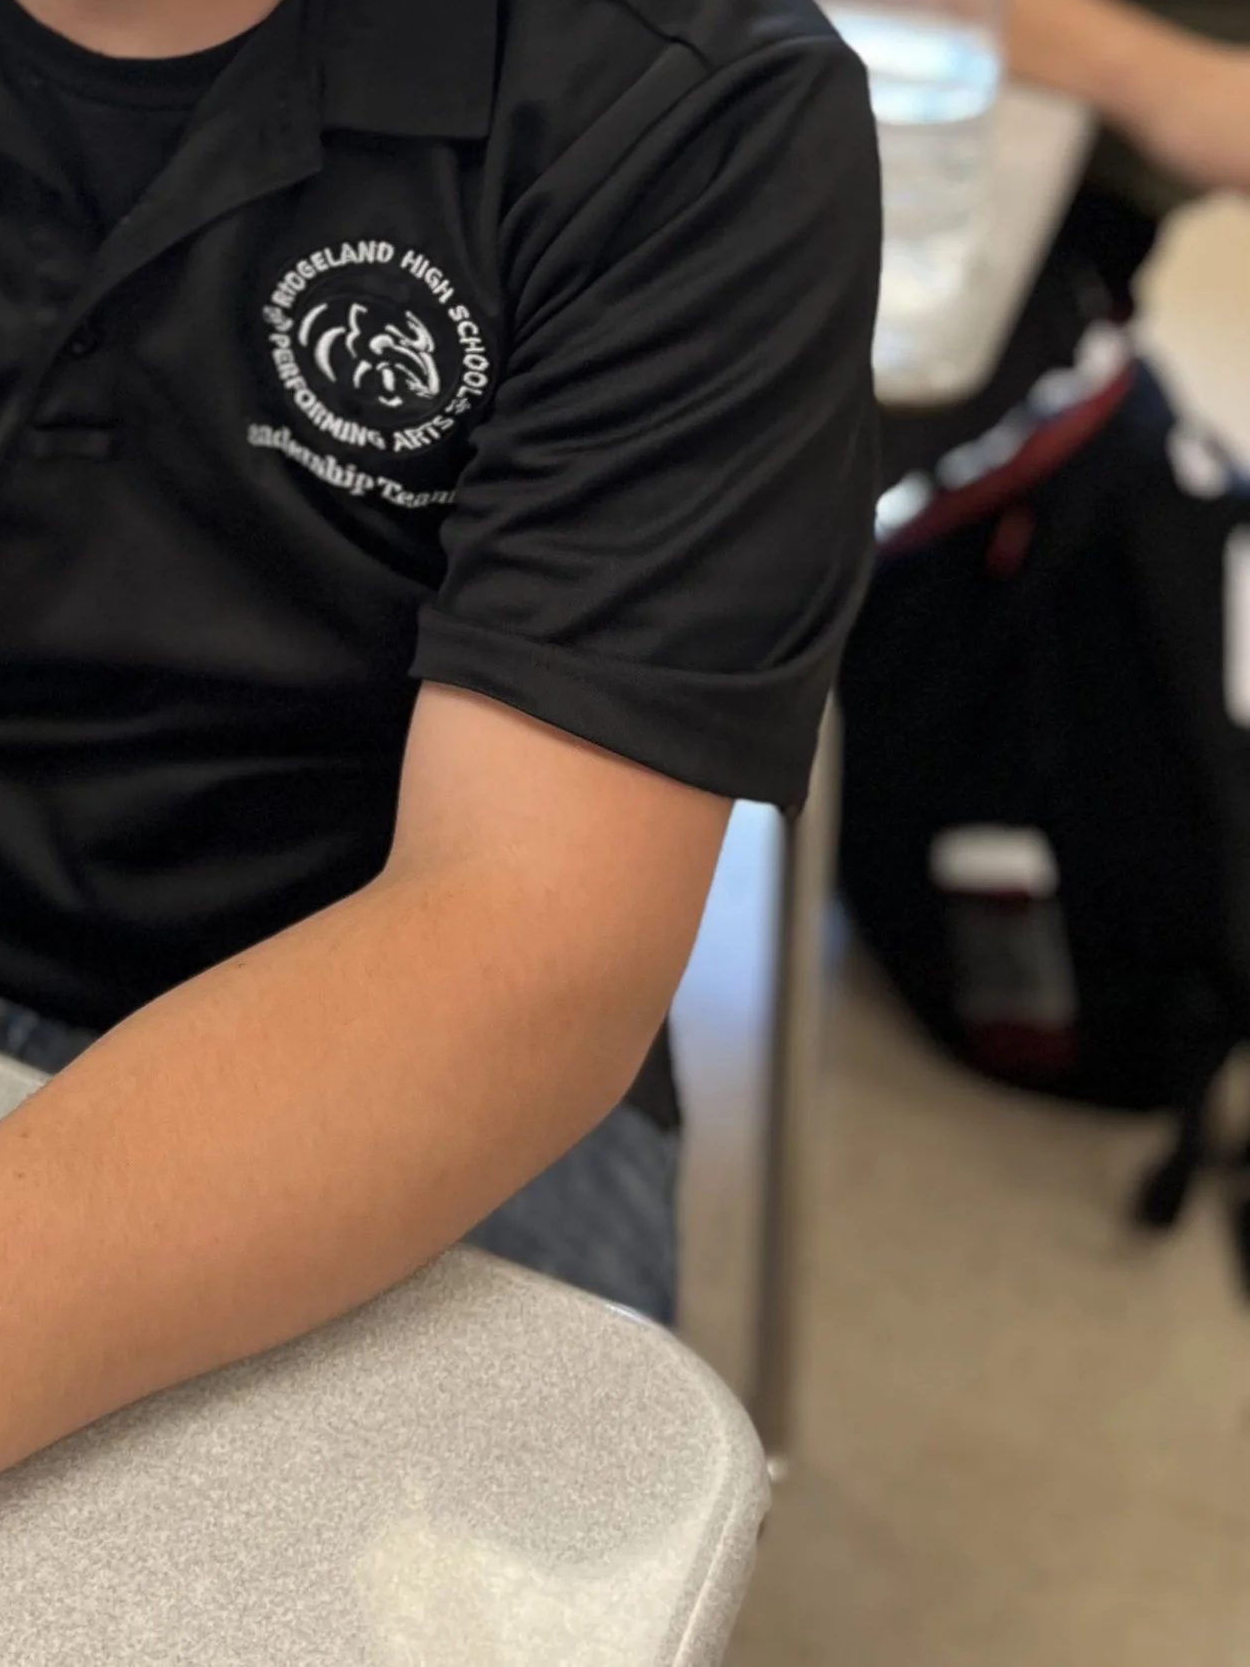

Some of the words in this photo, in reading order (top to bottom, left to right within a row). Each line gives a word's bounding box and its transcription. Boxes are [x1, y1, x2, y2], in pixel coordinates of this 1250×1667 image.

[270, 240, 394, 308] RIDGELAND
[401, 250, 454, 303] HIGH
[448, 305, 489, 397] SCHOOL
[270, 334, 385, 449] PERFORMING
[394, 416, 453, 451] ARTS
